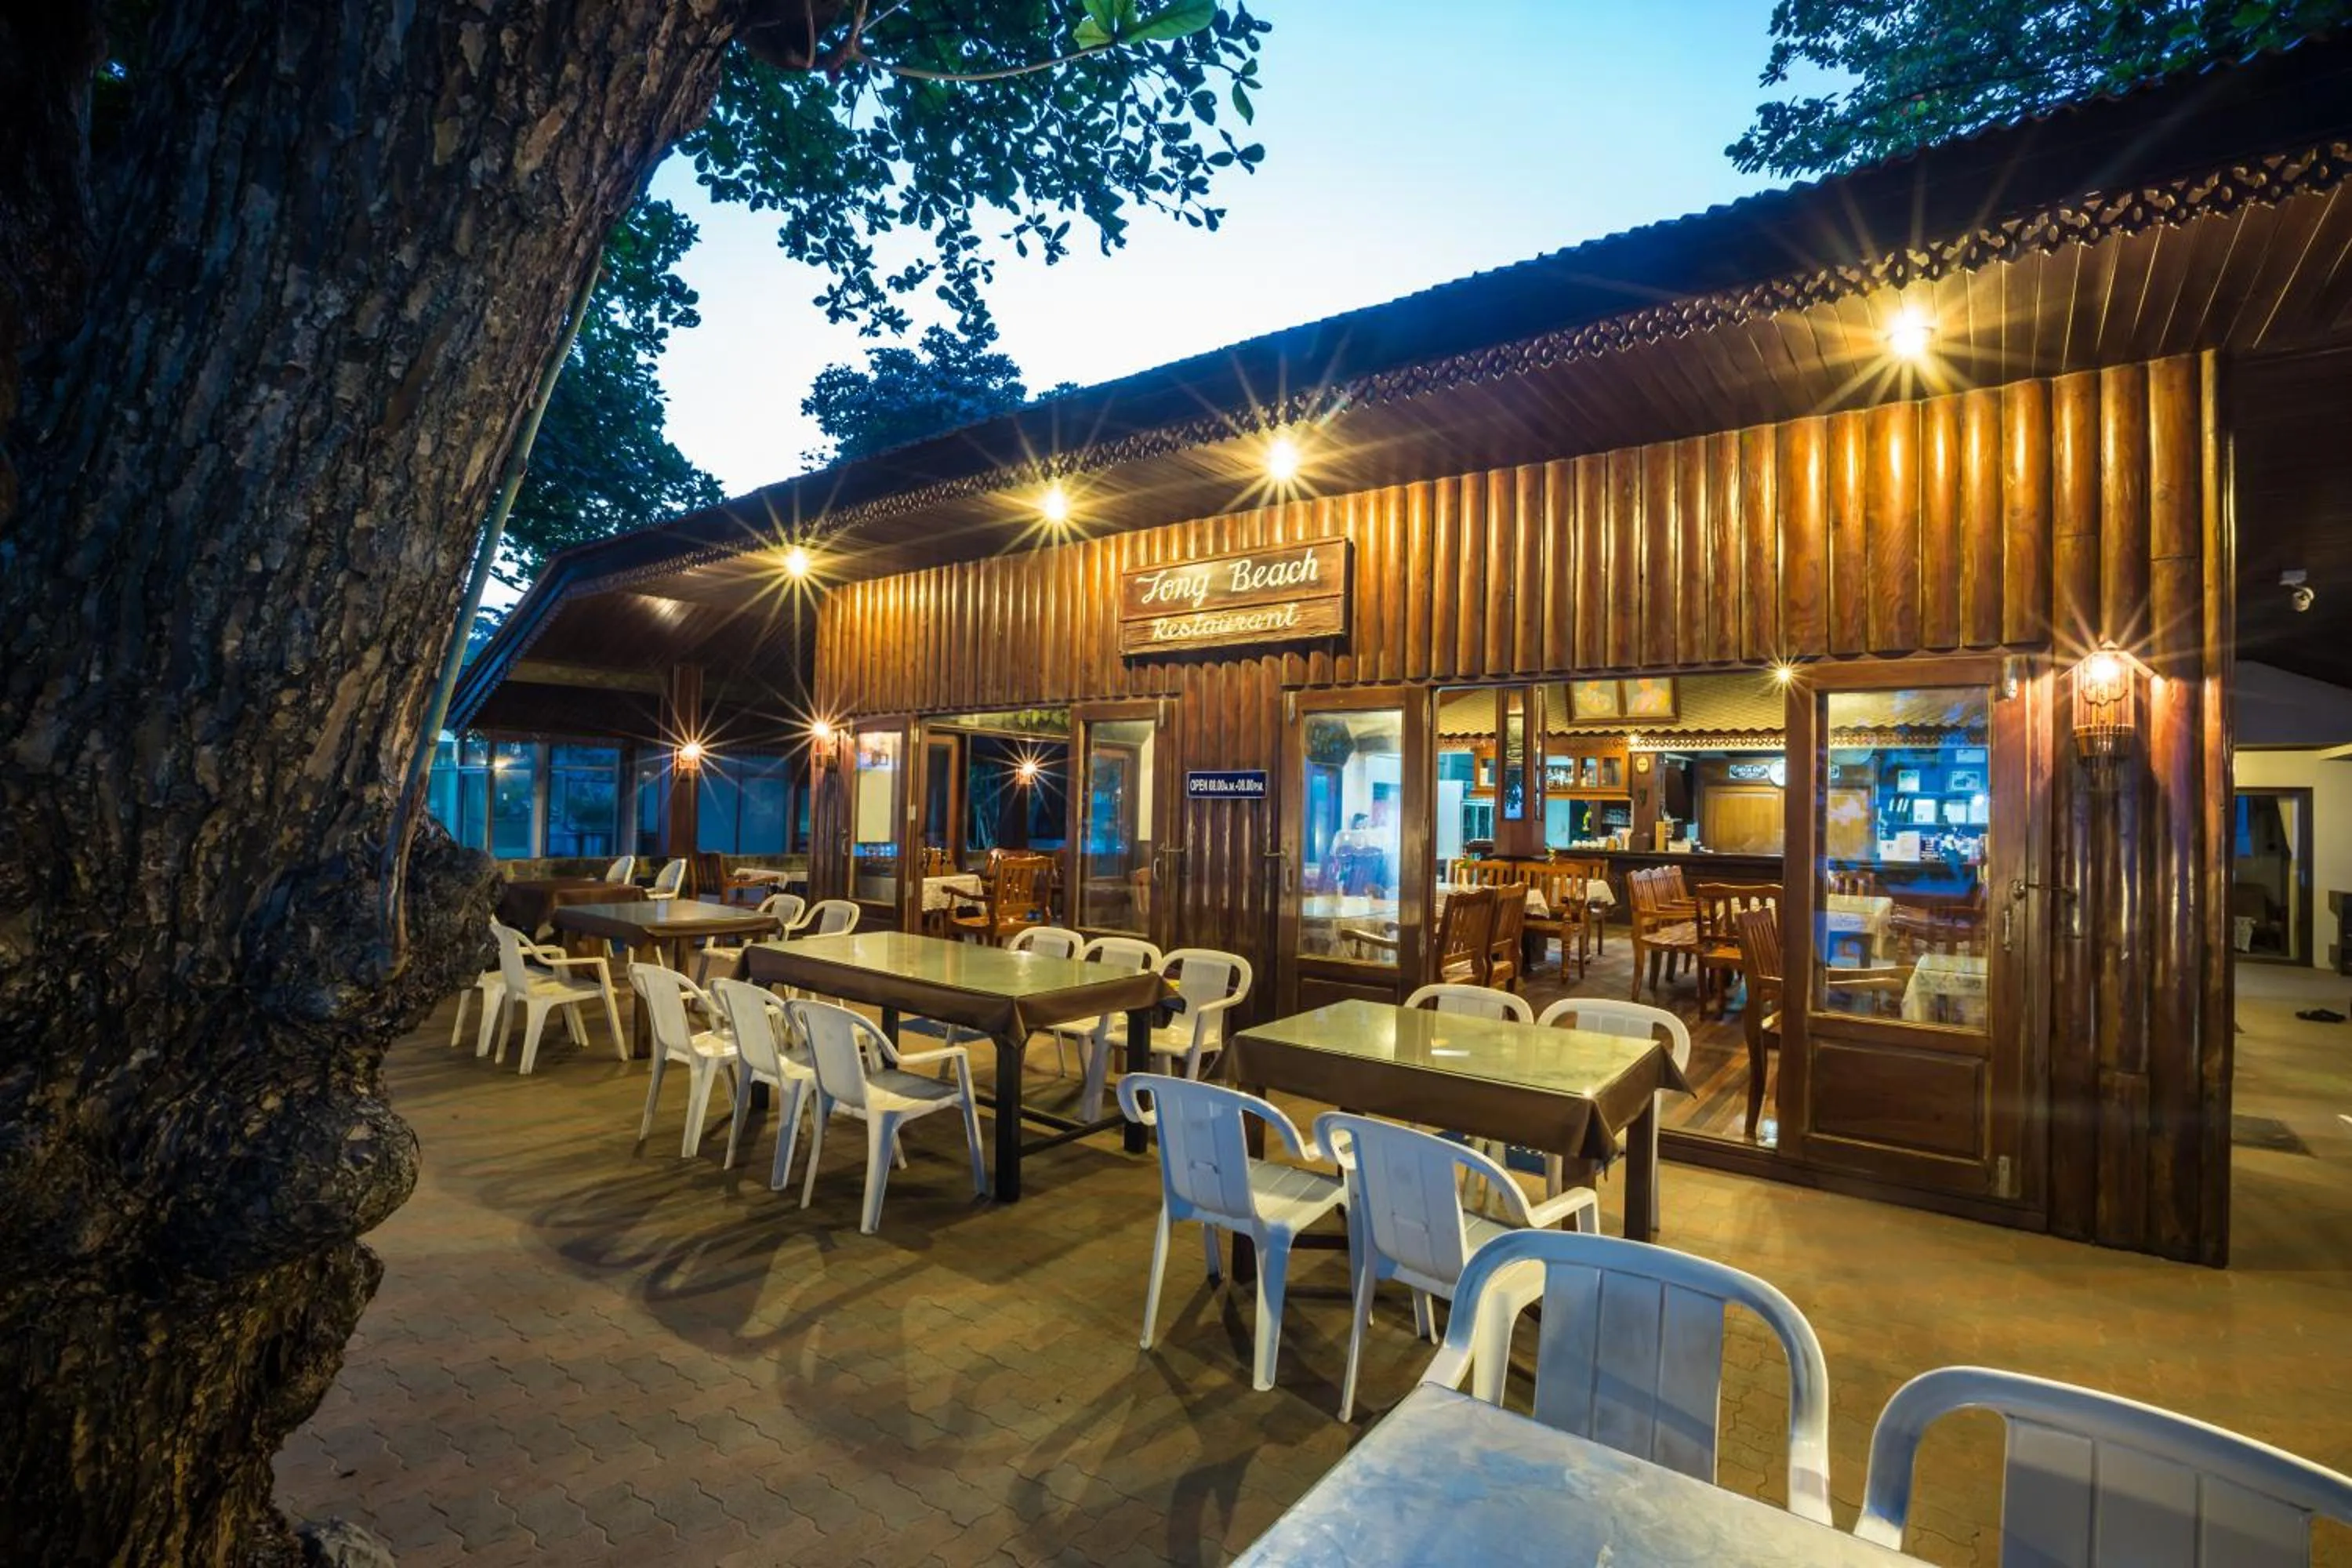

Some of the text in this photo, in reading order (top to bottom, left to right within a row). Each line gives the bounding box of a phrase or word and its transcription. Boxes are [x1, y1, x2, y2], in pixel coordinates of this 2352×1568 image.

[1228, 547, 1318, 592] Beach
[1152, 603, 1300, 641] Restaurant
[1189, 779, 1208, 791] OPEN
